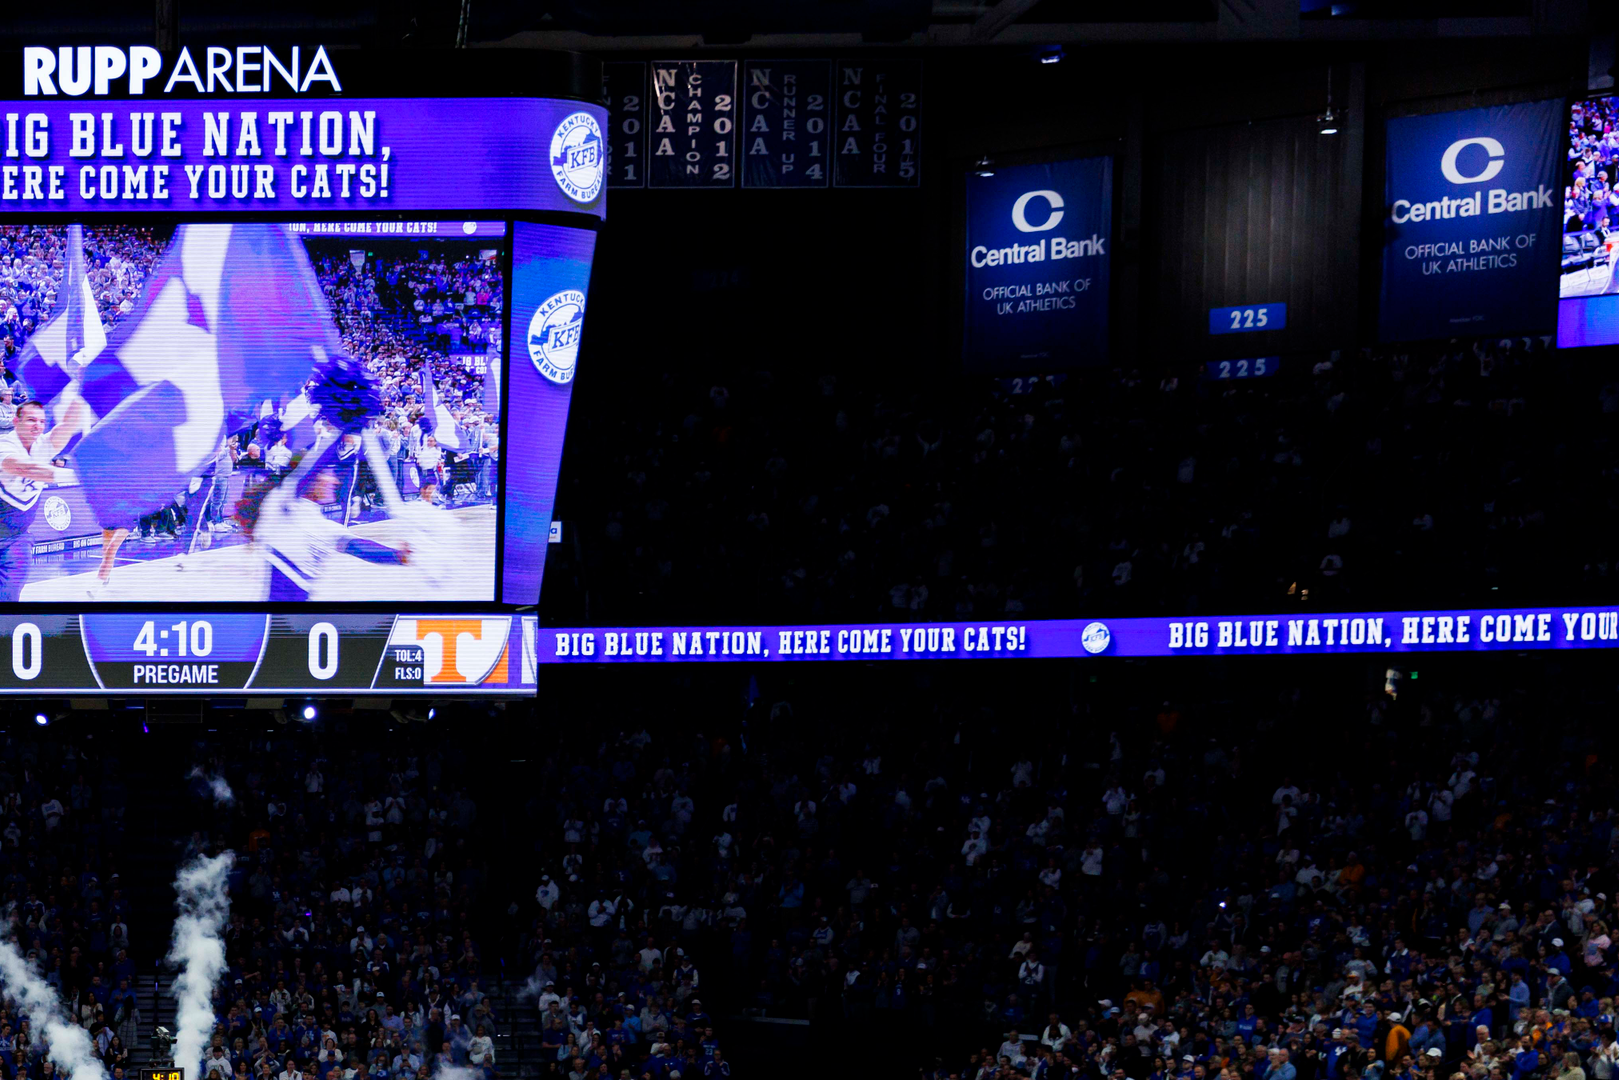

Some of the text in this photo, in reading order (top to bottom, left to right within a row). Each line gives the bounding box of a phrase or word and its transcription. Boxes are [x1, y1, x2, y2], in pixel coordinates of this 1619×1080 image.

[24, 46, 341, 95] RUPP ARENA
[556, 115, 599, 138] KENTUCKY
[655, 69, 677, 156] NCAA
[686, 74, 702, 175] CHAMPION
[749, 68, 771, 156] NCAA
[782, 74, 796, 174] RUNNER UP
[69, 111, 182, 158] BLUE
[202, 110, 392, 161] NATION,
[622, 95, 640, 181] 2011
[712, 95, 731, 180] 2012
[805, 95, 824, 180] 2014
[898, 93, 917, 179] 2015
[570, 152, 595, 169] KFB
[79, 165, 169, 199] COME
[185, 164, 276, 199] YOUR
[290, 163, 389, 198] CATS!
[555, 170, 579, 197] FARM
[1392, 185, 1554, 224] Central Bank
[971, 233, 1105, 268] Central Bank
[1405, 233, 1537, 261] OFFICIAL BANK OF
[1422, 252, 1518, 275] UK ATHLETICS
[983, 278, 1092, 302] OFFICIAL BANK OF
[997, 295, 1076, 316] UK ATHLETICS
[551, 324, 580, 349] KFB
[1230, 308, 1268, 329] 225
[533, 349, 557, 380] FARM
[1219, 358, 1266, 378] 225
[133, 620, 213, 657] 4:10
[555, 626, 1026, 659] BIG BLUE NATION, HERE COME YOUR CATS!
[1168, 611, 1619, 649] BIG BLUE NATION, HERE COME YOUR
[12, 622, 41, 680] 0
[309, 622, 338, 680] 0
[395, 650, 421, 663] TOL:4
[415, 619, 482, 683] T
[133, 664, 219, 684] PREGAME
[395, 668, 421, 681] FLS:0
